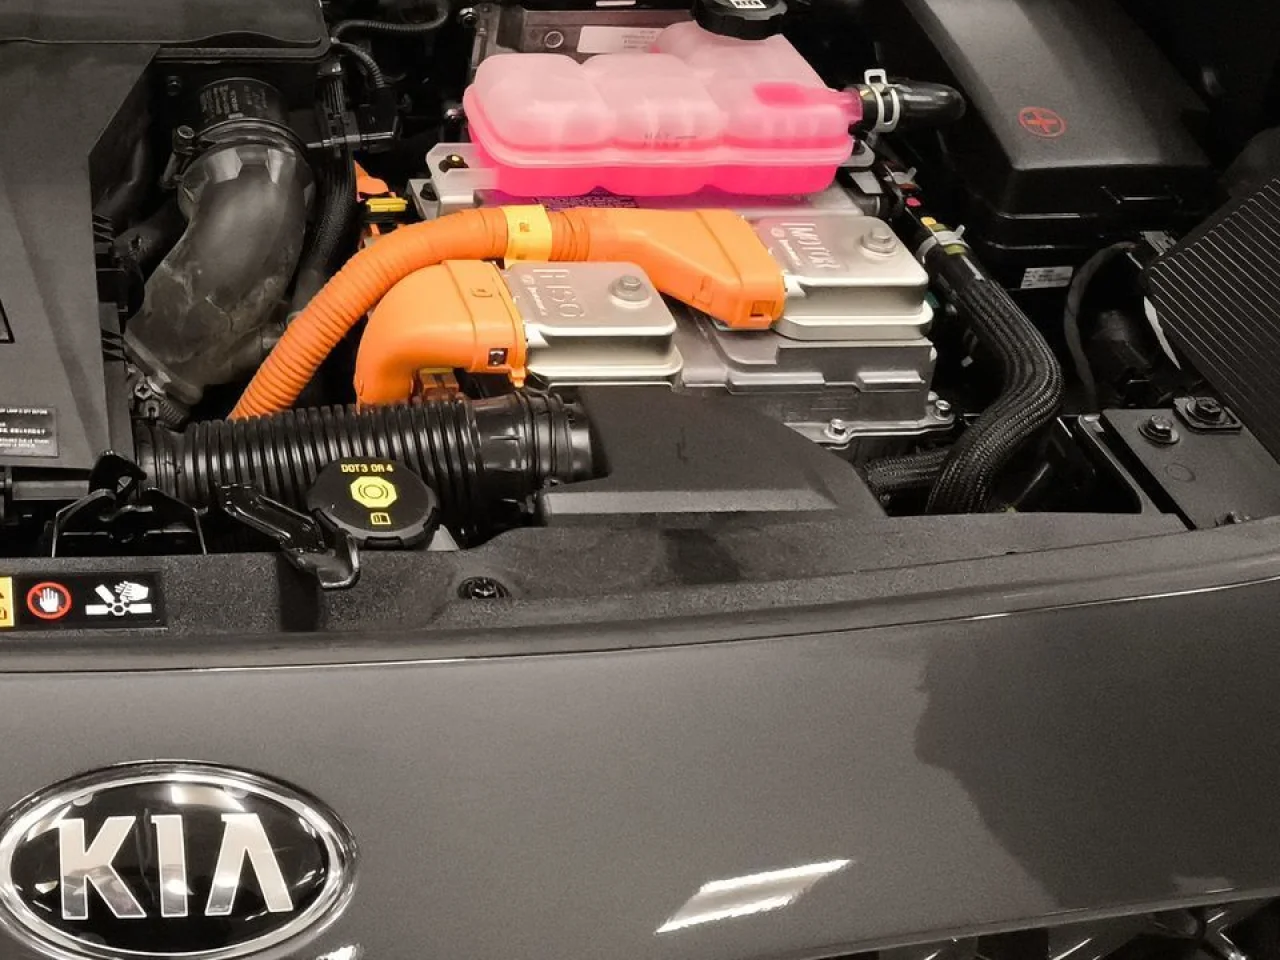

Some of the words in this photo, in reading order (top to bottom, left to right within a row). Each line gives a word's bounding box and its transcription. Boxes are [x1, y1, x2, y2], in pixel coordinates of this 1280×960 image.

[370, 463, 386, 473] OR
[386, 463, 394, 472] 4
[58, 812, 294, 921] KIA
